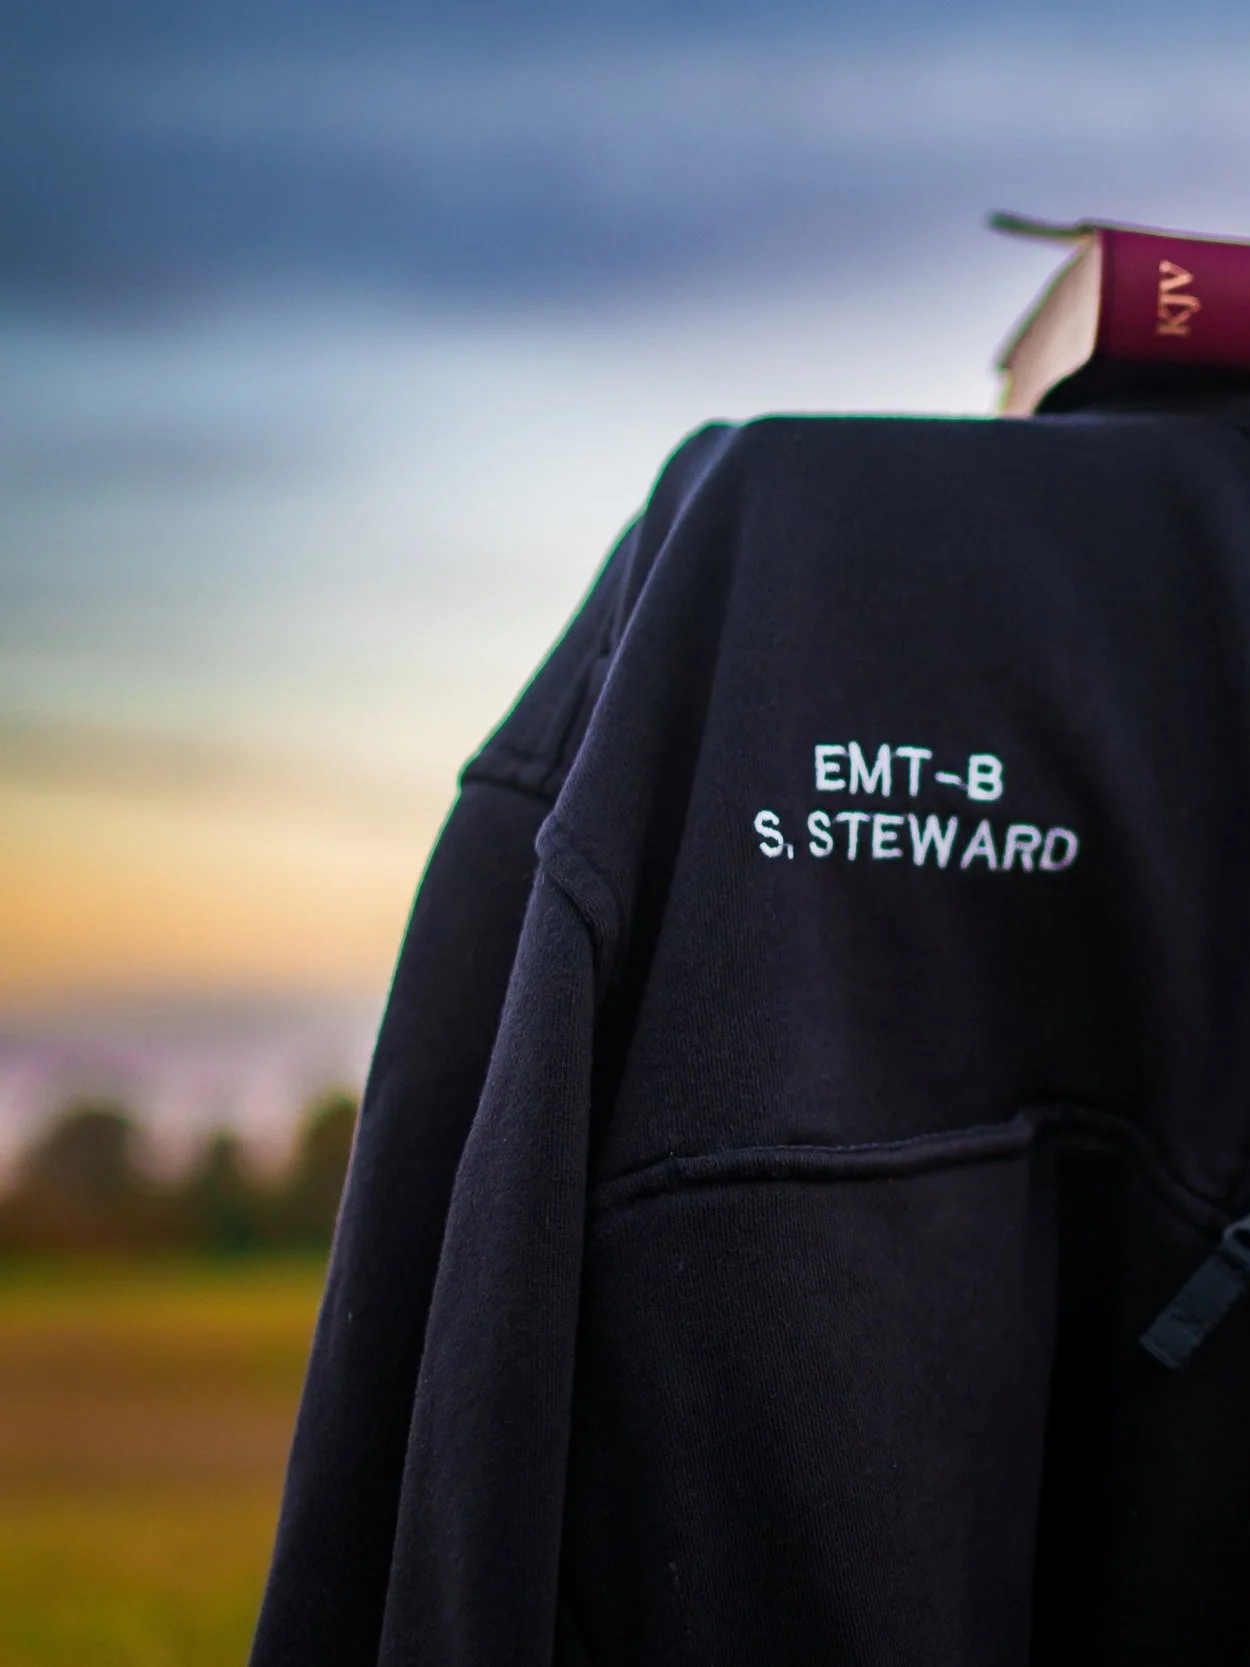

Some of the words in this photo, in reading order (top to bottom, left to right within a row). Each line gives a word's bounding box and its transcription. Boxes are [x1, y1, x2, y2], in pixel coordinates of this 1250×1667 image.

[1157, 260, 1200, 336] KJV
[814, 741, 1003, 801] EMT-B
[806, 810, 1079, 873] STEWARD
